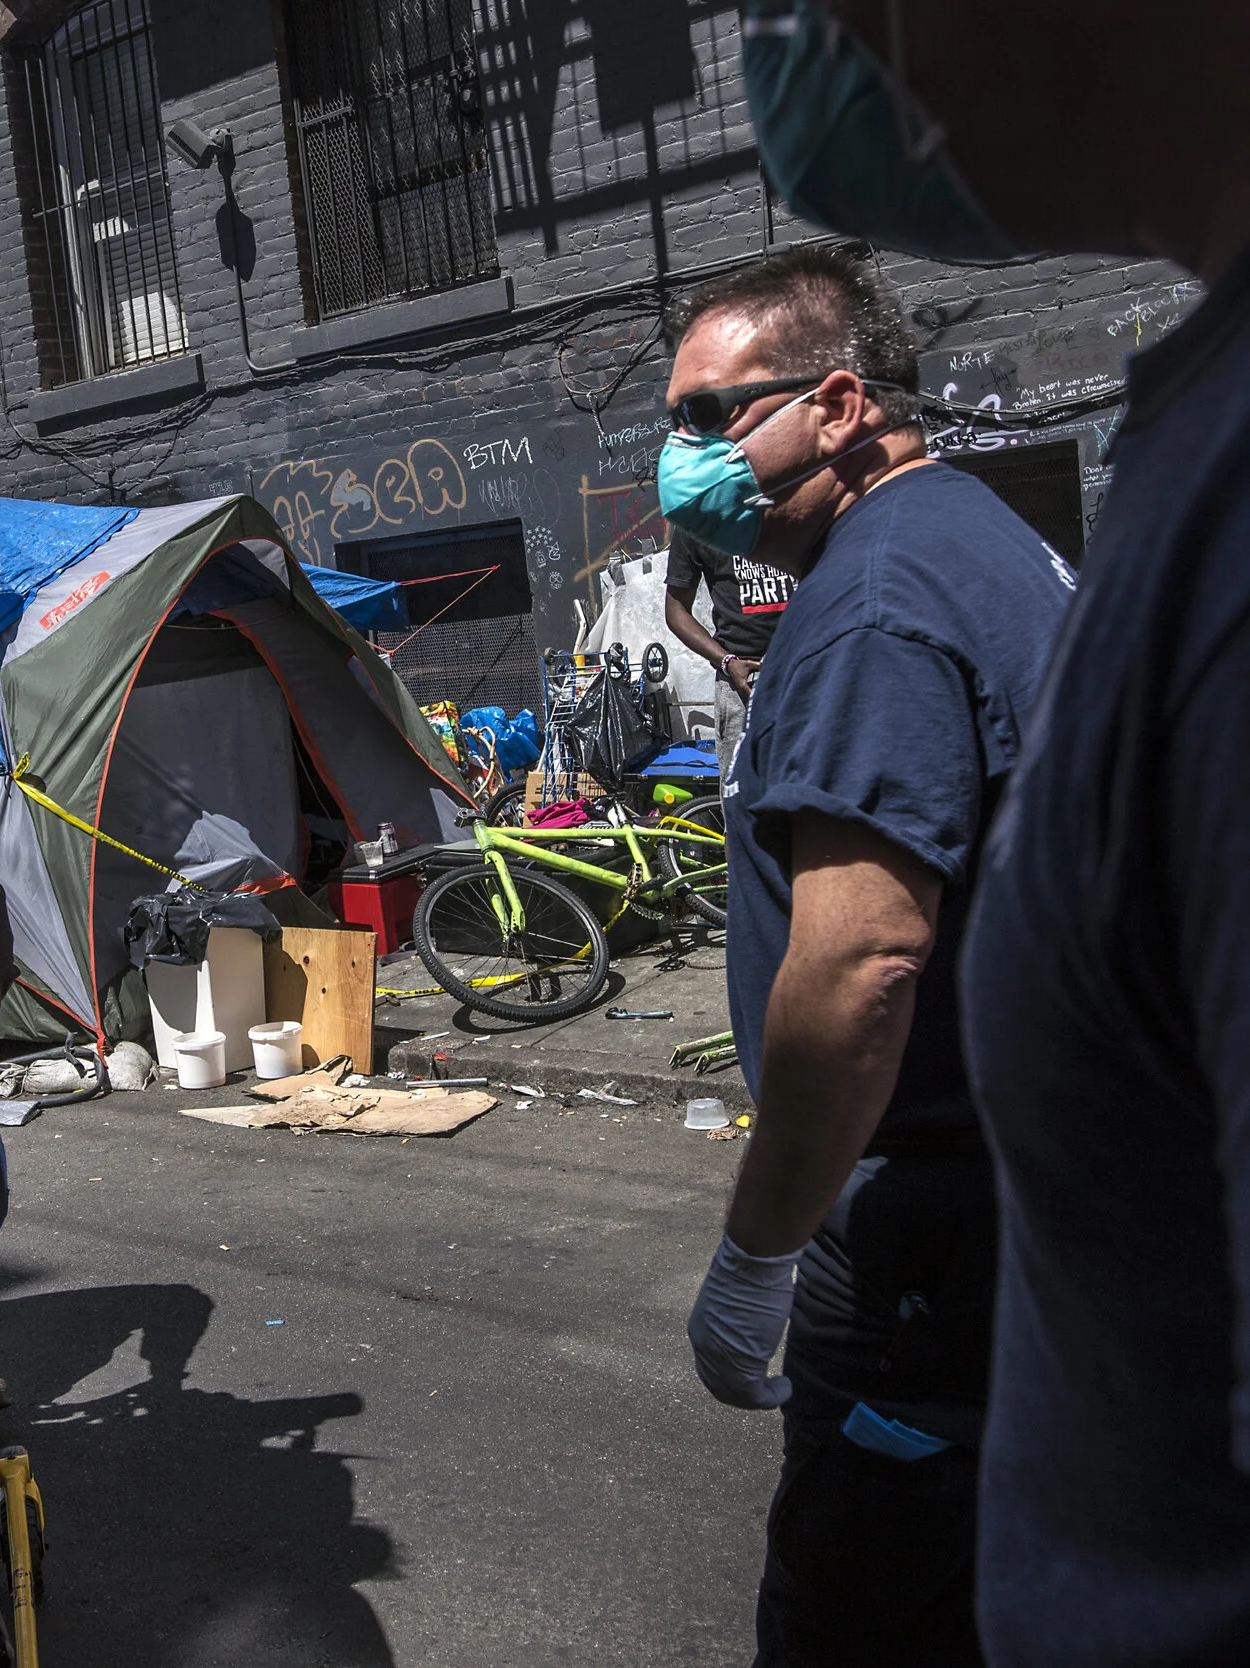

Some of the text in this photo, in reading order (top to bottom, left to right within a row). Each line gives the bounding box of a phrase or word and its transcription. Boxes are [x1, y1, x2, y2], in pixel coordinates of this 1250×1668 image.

[463, 436, 533, 470] BTM
[734, 568, 765, 581] KNOWS
[739, 575, 799, 606] PARTY
